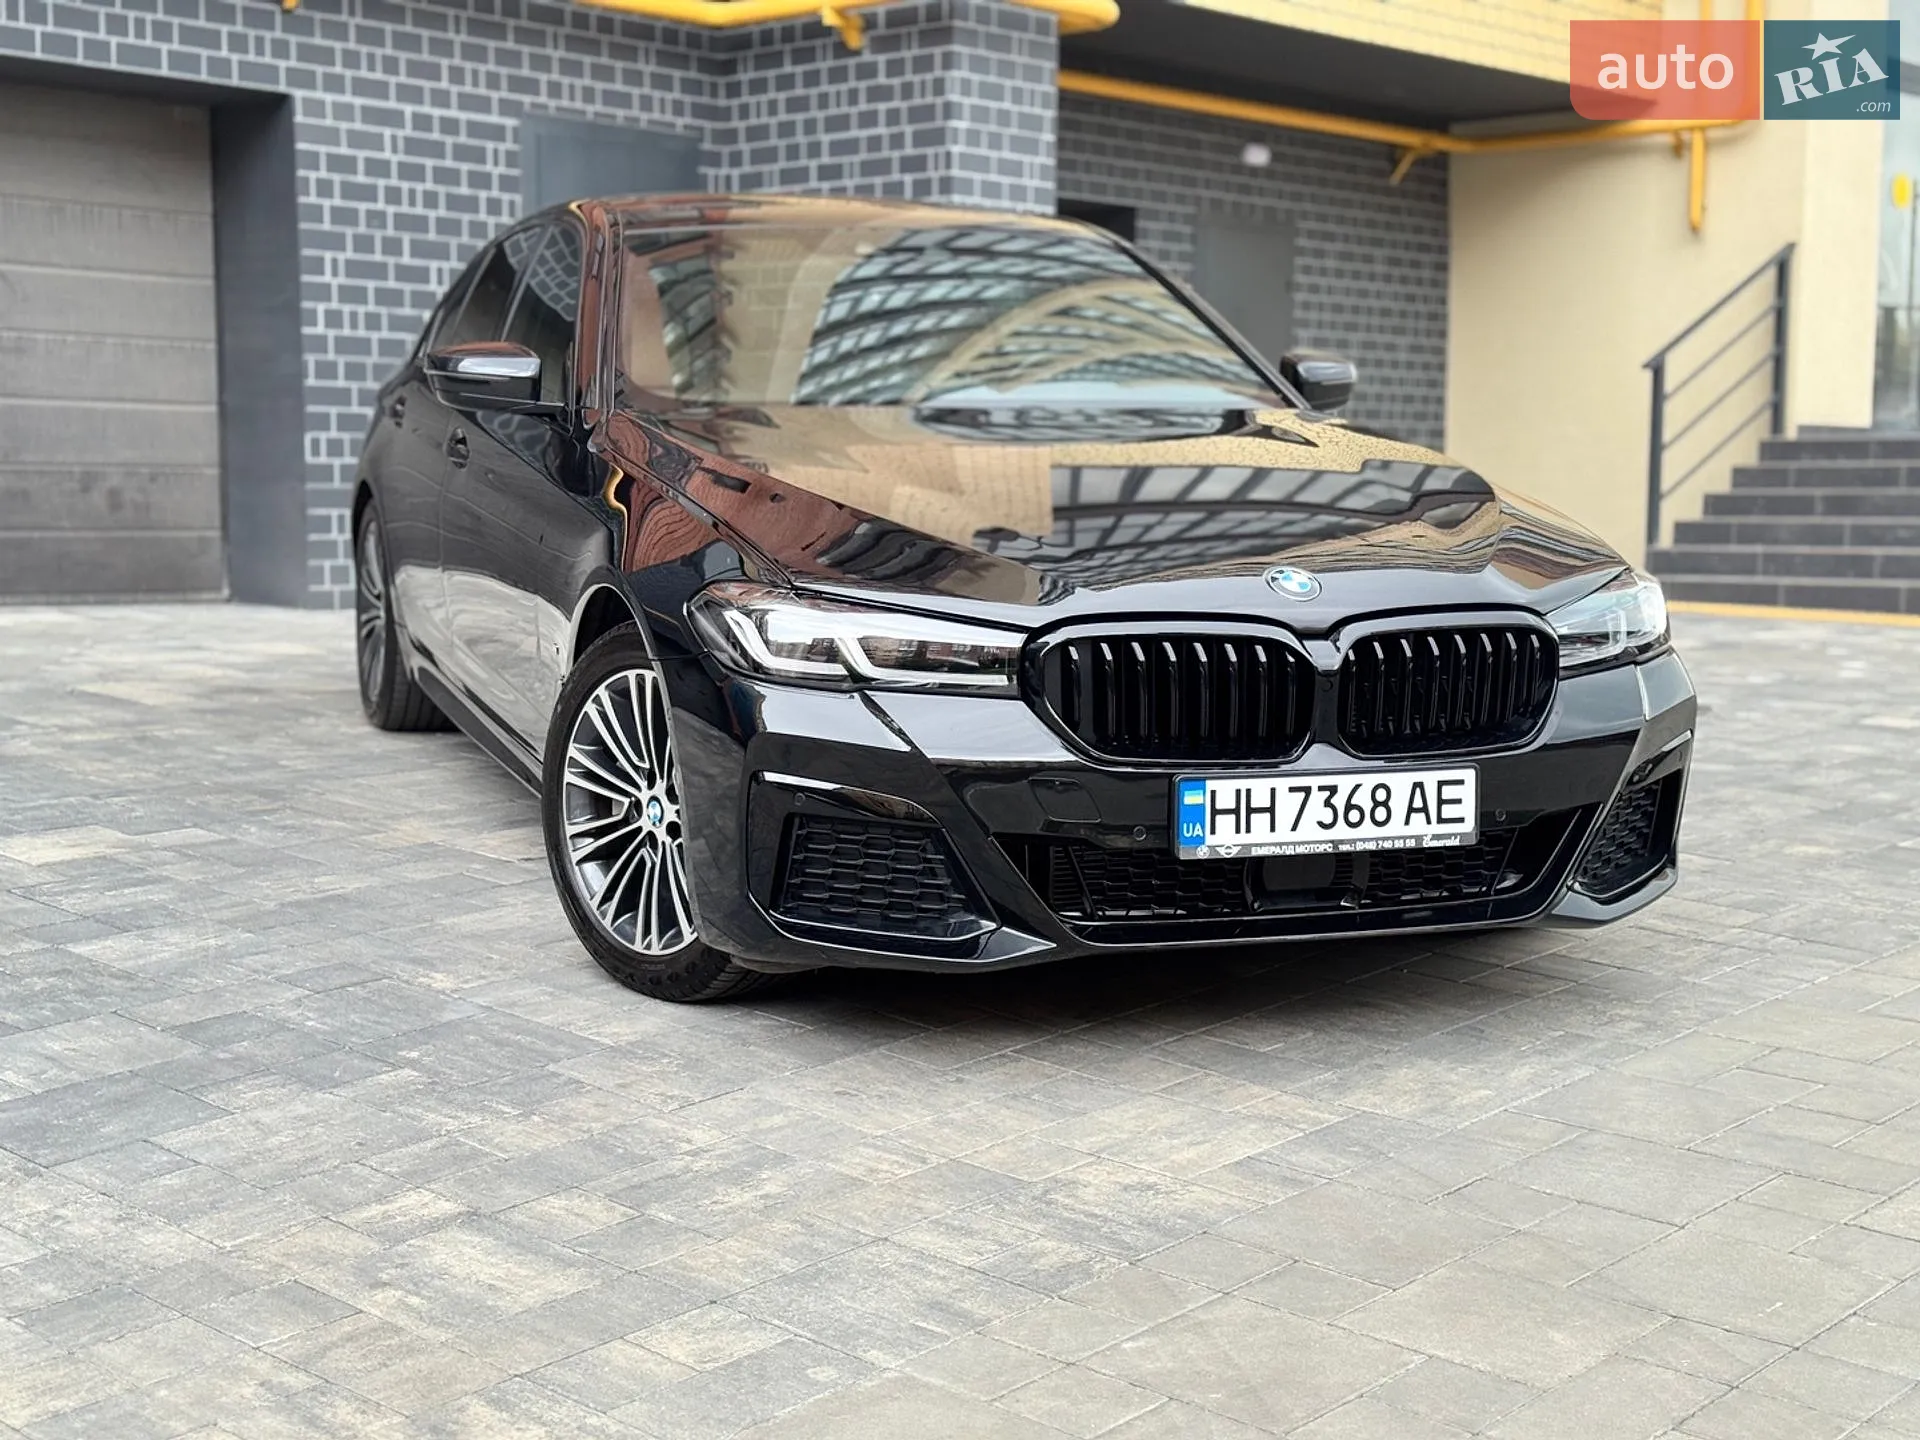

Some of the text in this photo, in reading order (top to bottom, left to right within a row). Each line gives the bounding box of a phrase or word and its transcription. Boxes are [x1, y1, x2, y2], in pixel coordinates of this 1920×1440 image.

[1209, 779, 1465, 835] HH 7368 AE
[1183, 822, 1203, 838] UA
